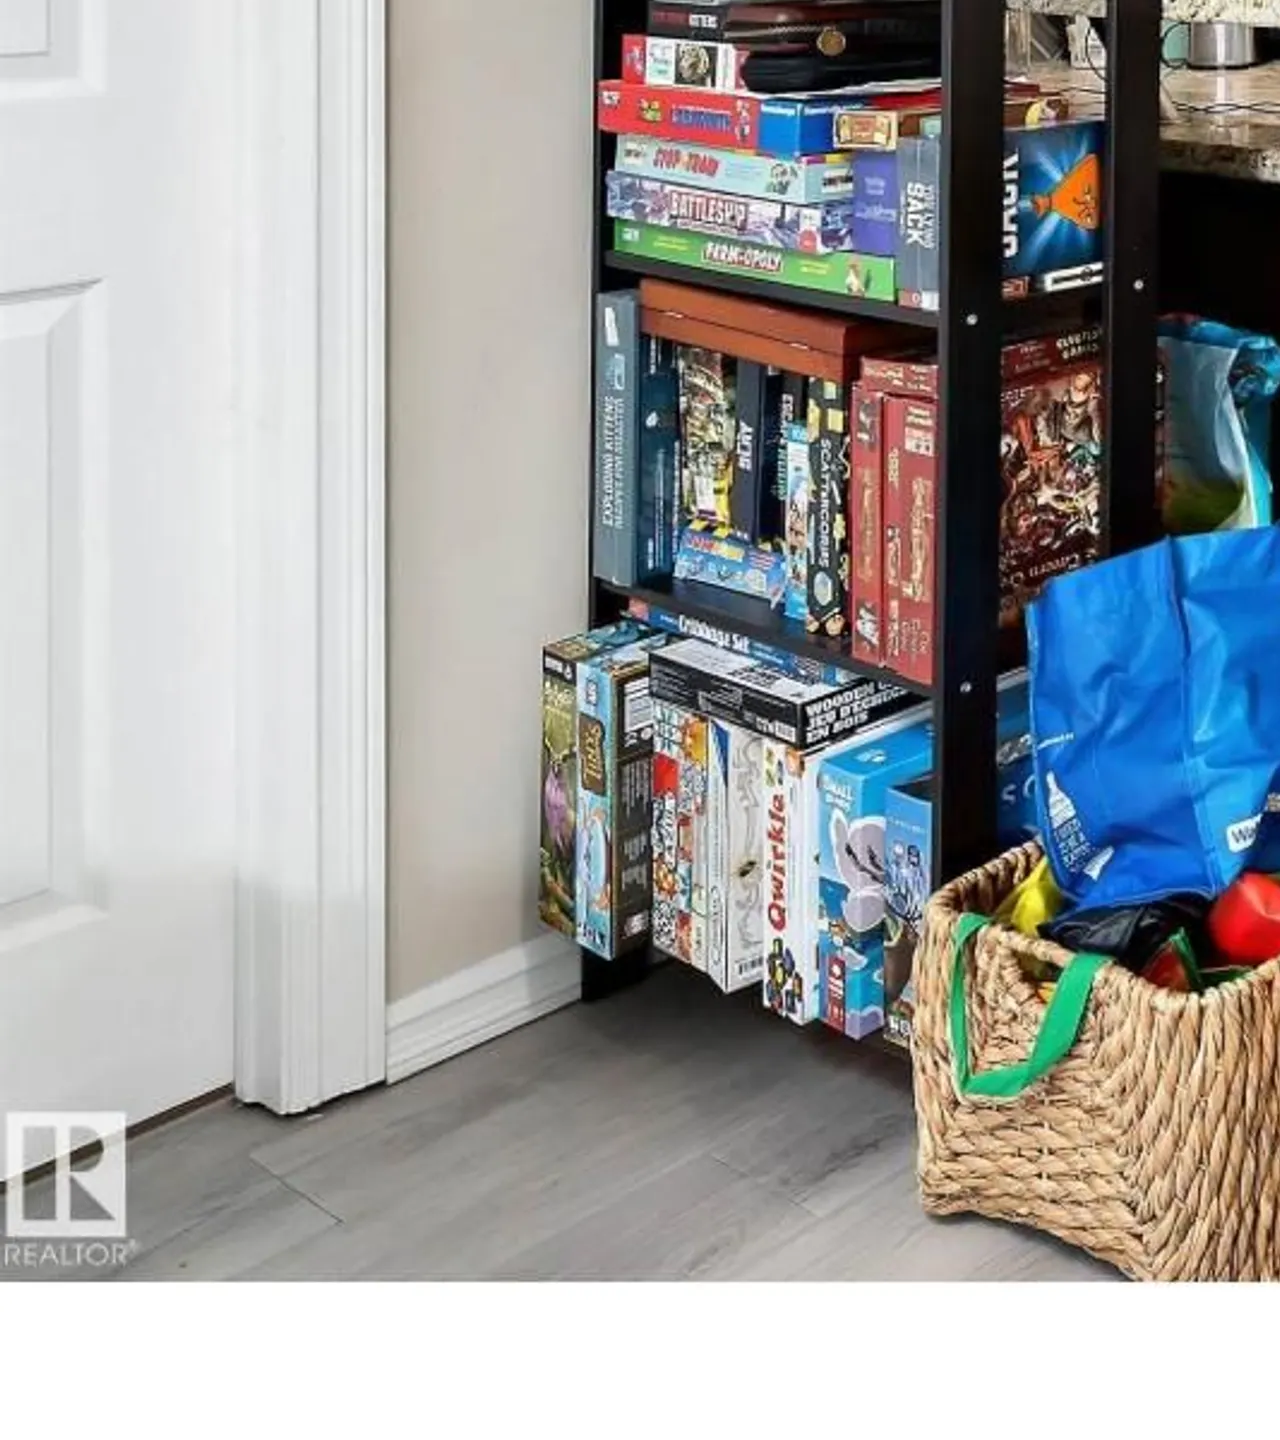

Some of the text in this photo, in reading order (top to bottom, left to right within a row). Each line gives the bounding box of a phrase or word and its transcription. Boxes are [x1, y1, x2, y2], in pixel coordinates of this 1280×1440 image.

[906, 182, 924, 248] SACK
[602, 396, 616, 526] EXPLODING KITTENS
[806, 682, 875, 717] WOODEN
[767, 794, 787, 931] Qwirkle
